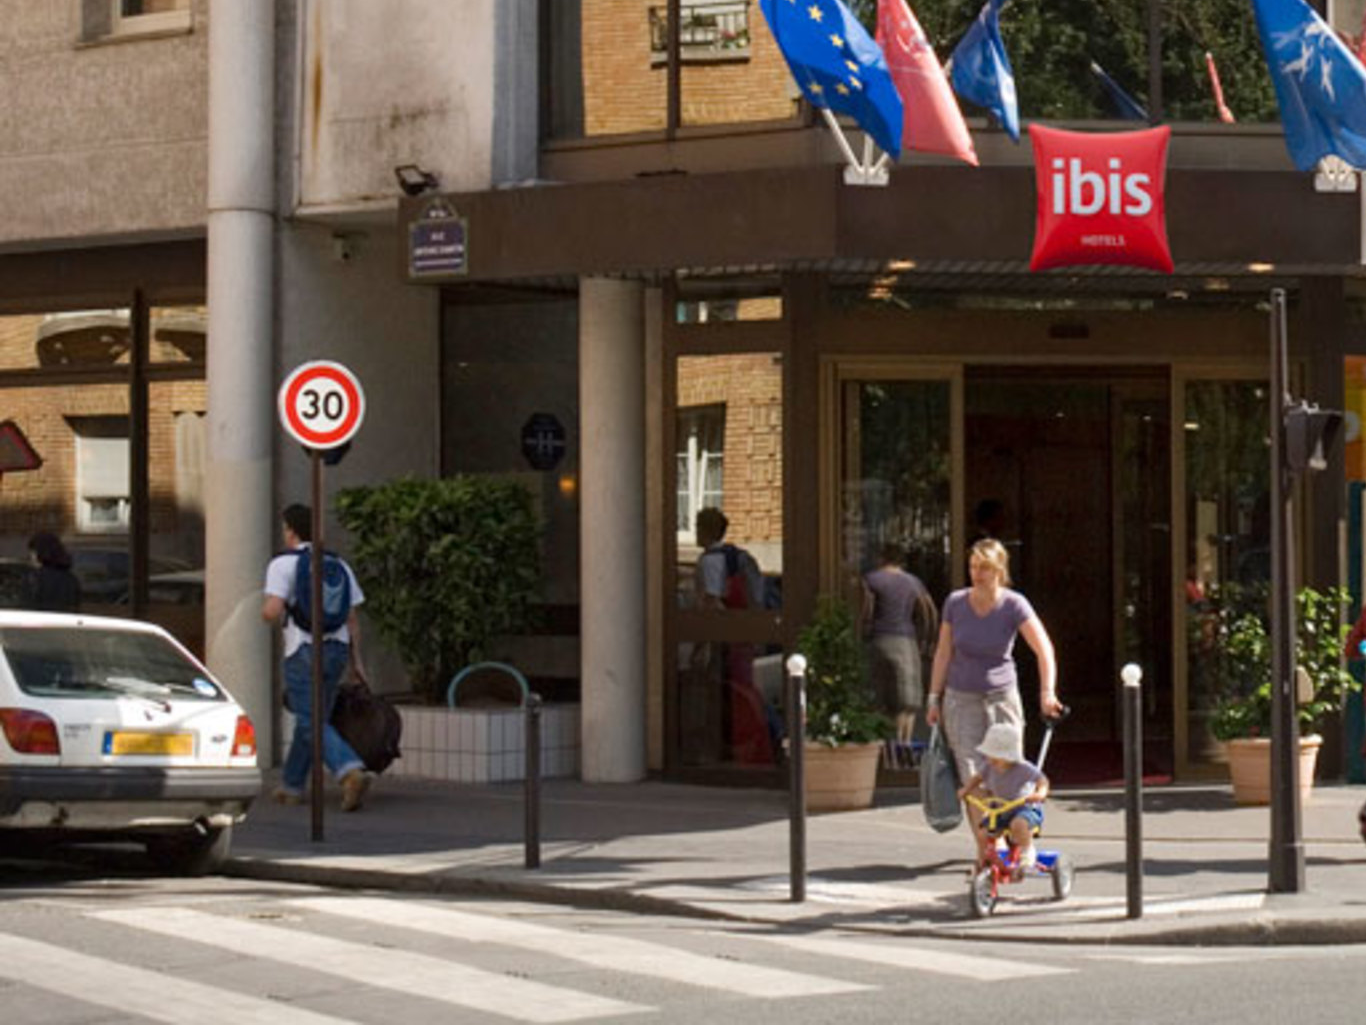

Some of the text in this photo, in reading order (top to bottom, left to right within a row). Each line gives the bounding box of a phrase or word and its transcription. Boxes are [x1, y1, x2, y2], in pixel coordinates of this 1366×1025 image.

[1052, 157, 1153, 216] ibis
[1080, 234, 1126, 247] HOTELS
[301, 389, 344, 420] 30
